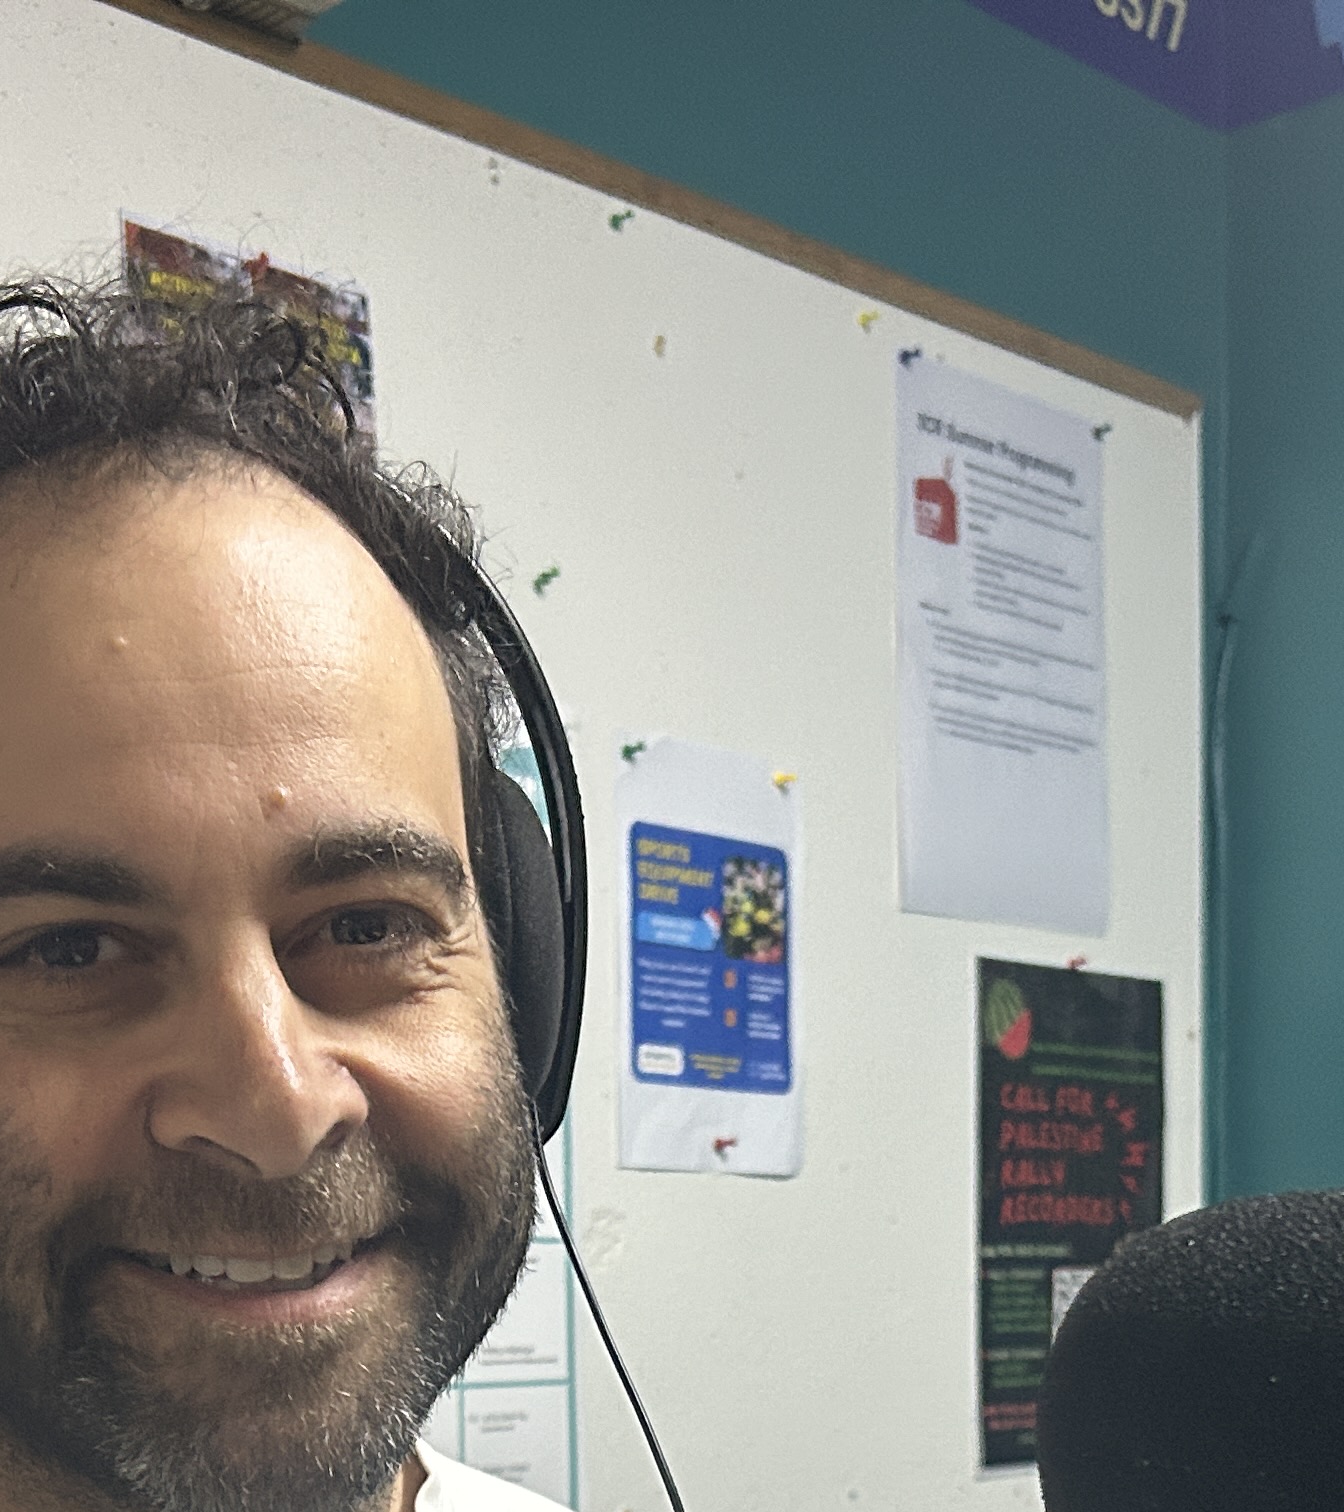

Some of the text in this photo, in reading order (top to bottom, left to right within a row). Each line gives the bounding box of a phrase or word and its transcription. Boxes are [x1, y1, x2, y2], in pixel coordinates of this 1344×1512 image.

[1000, 1083, 1094, 1118] CALL FOR
[1000, 1120, 1104, 1153] PALESTINE
